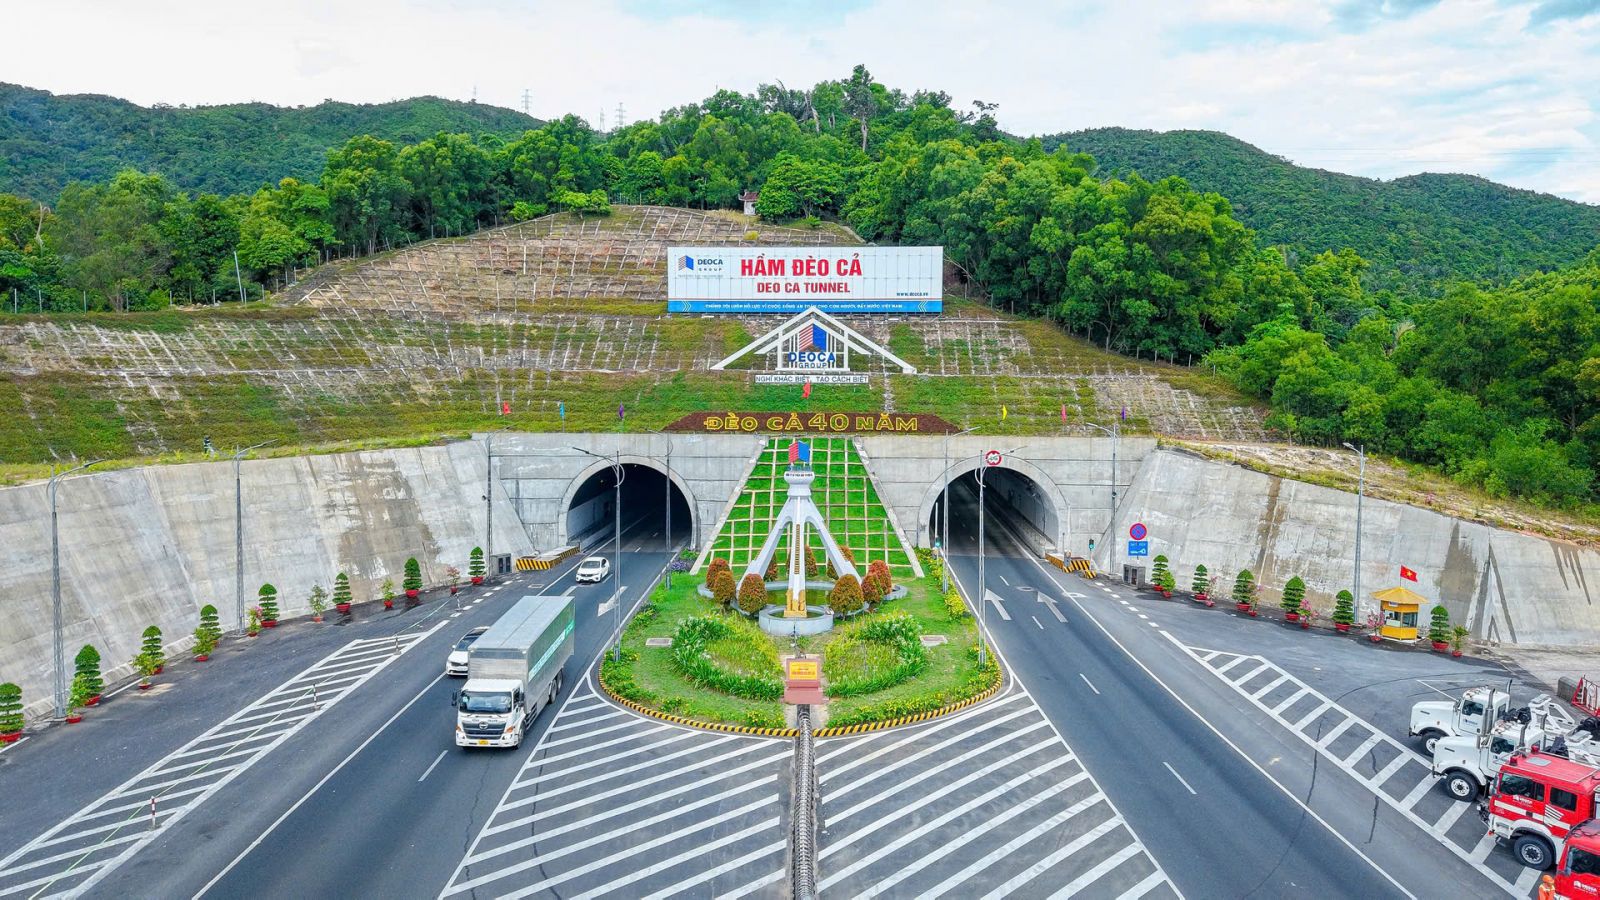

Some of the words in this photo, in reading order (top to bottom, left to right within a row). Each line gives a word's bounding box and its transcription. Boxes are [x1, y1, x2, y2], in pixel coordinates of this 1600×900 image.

[741, 253, 785, 276] HẦM
[792, 255, 829, 276] ĐÈO
[836, 253, 862, 276] CẢ
[757, 282, 780, 293] DEO
[785, 282, 800, 293] CA
[804, 282, 850, 293] TUNNEL
[788, 352, 835, 362] DEOCA
[853, 375, 867, 383] BIỆT
[703, 412, 758, 431] ĐÈO
[766, 412, 804, 431] CẢ
[808, 413, 849, 431] 40
[855, 413, 918, 431] NĂM
